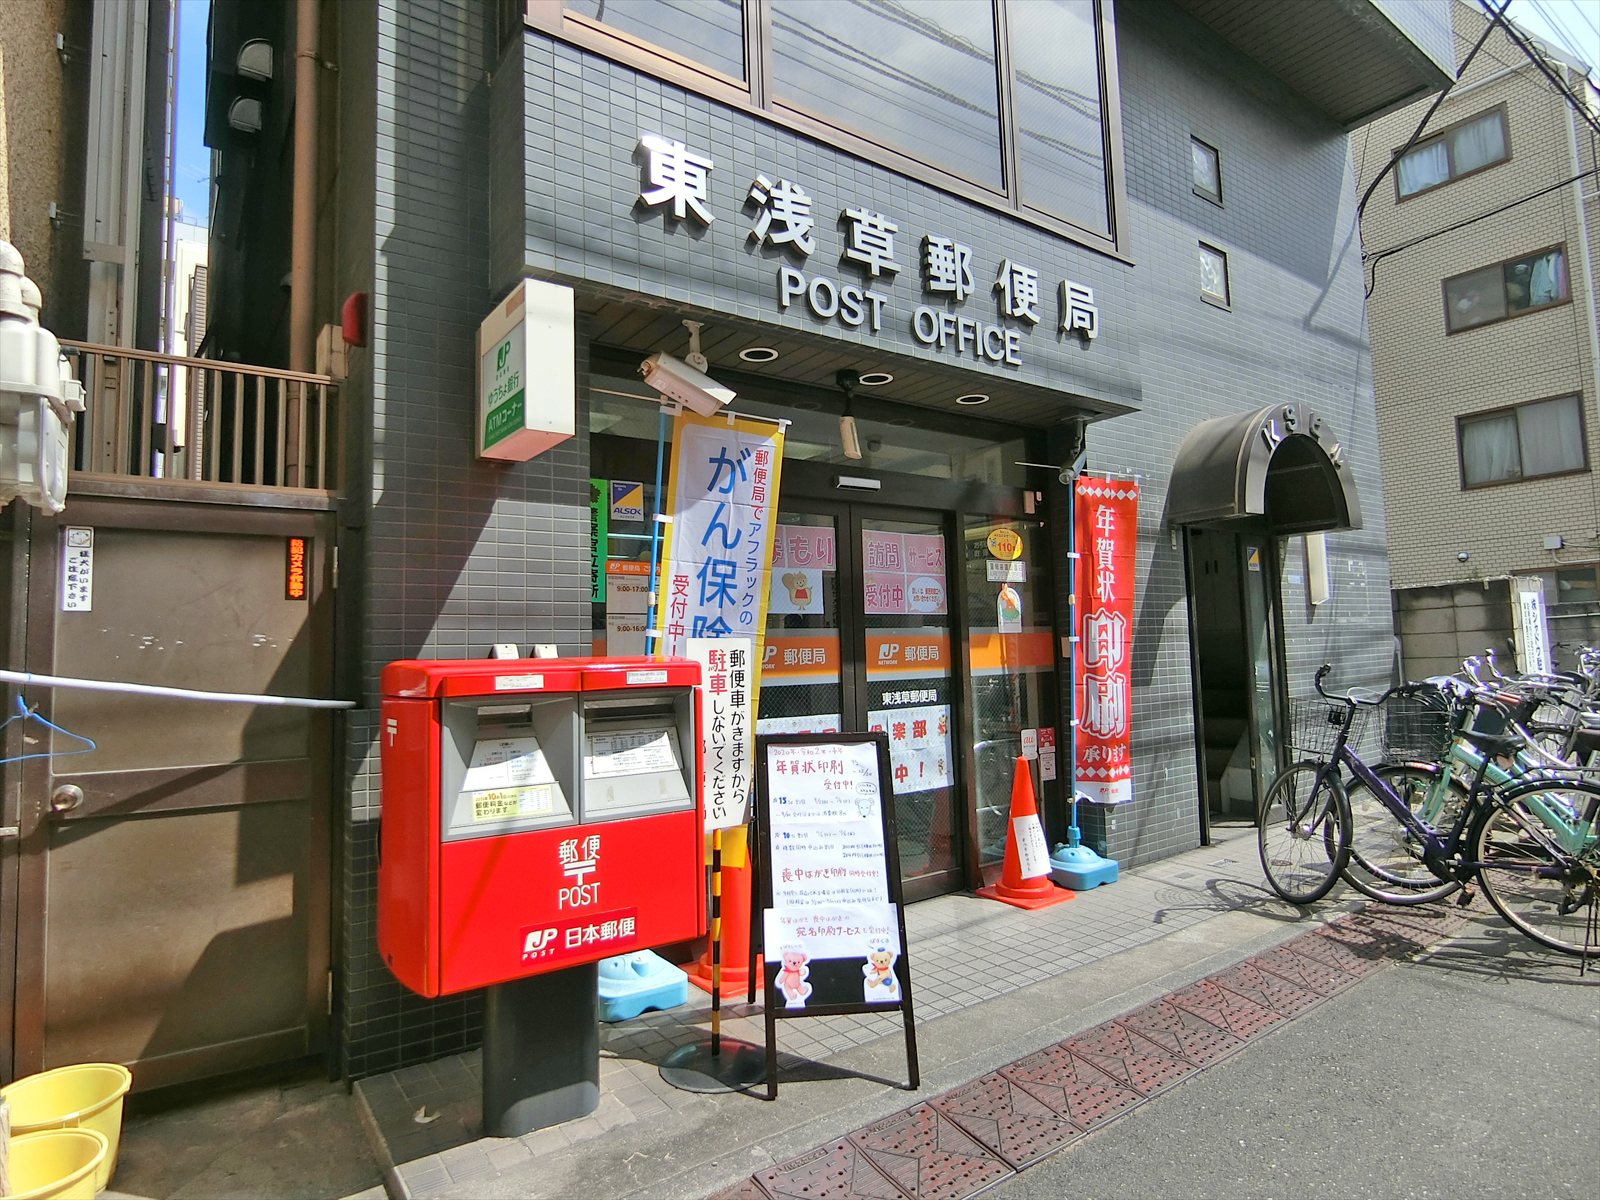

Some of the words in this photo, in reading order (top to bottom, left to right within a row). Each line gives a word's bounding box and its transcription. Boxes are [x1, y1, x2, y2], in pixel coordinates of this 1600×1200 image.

[636, 134, 1100, 341] 東浅草郵便局
[779, 266, 888, 332] POST
[912, 305, 1023, 366] OFFICE
[497, 341, 511, 371] JP
[488, 371, 519, 407] ゆうちょ銀行
[488, 401, 522, 432] ATMコーナー
[613, 507, 642, 516] ALSOK
[739, 449, 770, 626] 郵便局でアフラックの
[867, 541, 900, 569] 訪問
[908, 547, 944, 568] サービス
[1096, 504, 1115, 603] 年賀状
[622, 564, 640, 572] 郵便局
[865, 583, 904, 609] 受付中
[783, 648, 826, 665] 郵便局
[878, 643, 900, 660] JP
[905, 645, 939, 661] 郵便局
[1082, 608, 1126, 739] 印刷
[882, 689, 937, 705] 東浅草郵便局
[708, 649, 728, 820] 駐車しないでください
[729, 649, 746, 805] 郵便車がきますから
[775, 758, 844, 775] 年賀状印刷
[1082, 743, 1127, 764] 承ります
[823, 778, 854, 790] 受付中!
[475, 800, 518, 810] 郵便料金などが
[558, 834, 601, 865] 郵便
[781, 867, 847, 883] 喪中はがき印刷
[558, 882, 601, 910] POST
[523, 928, 558, 953] JP
[565, 916, 636, 949] 日本郵便
[521, 948, 556, 960] POST
